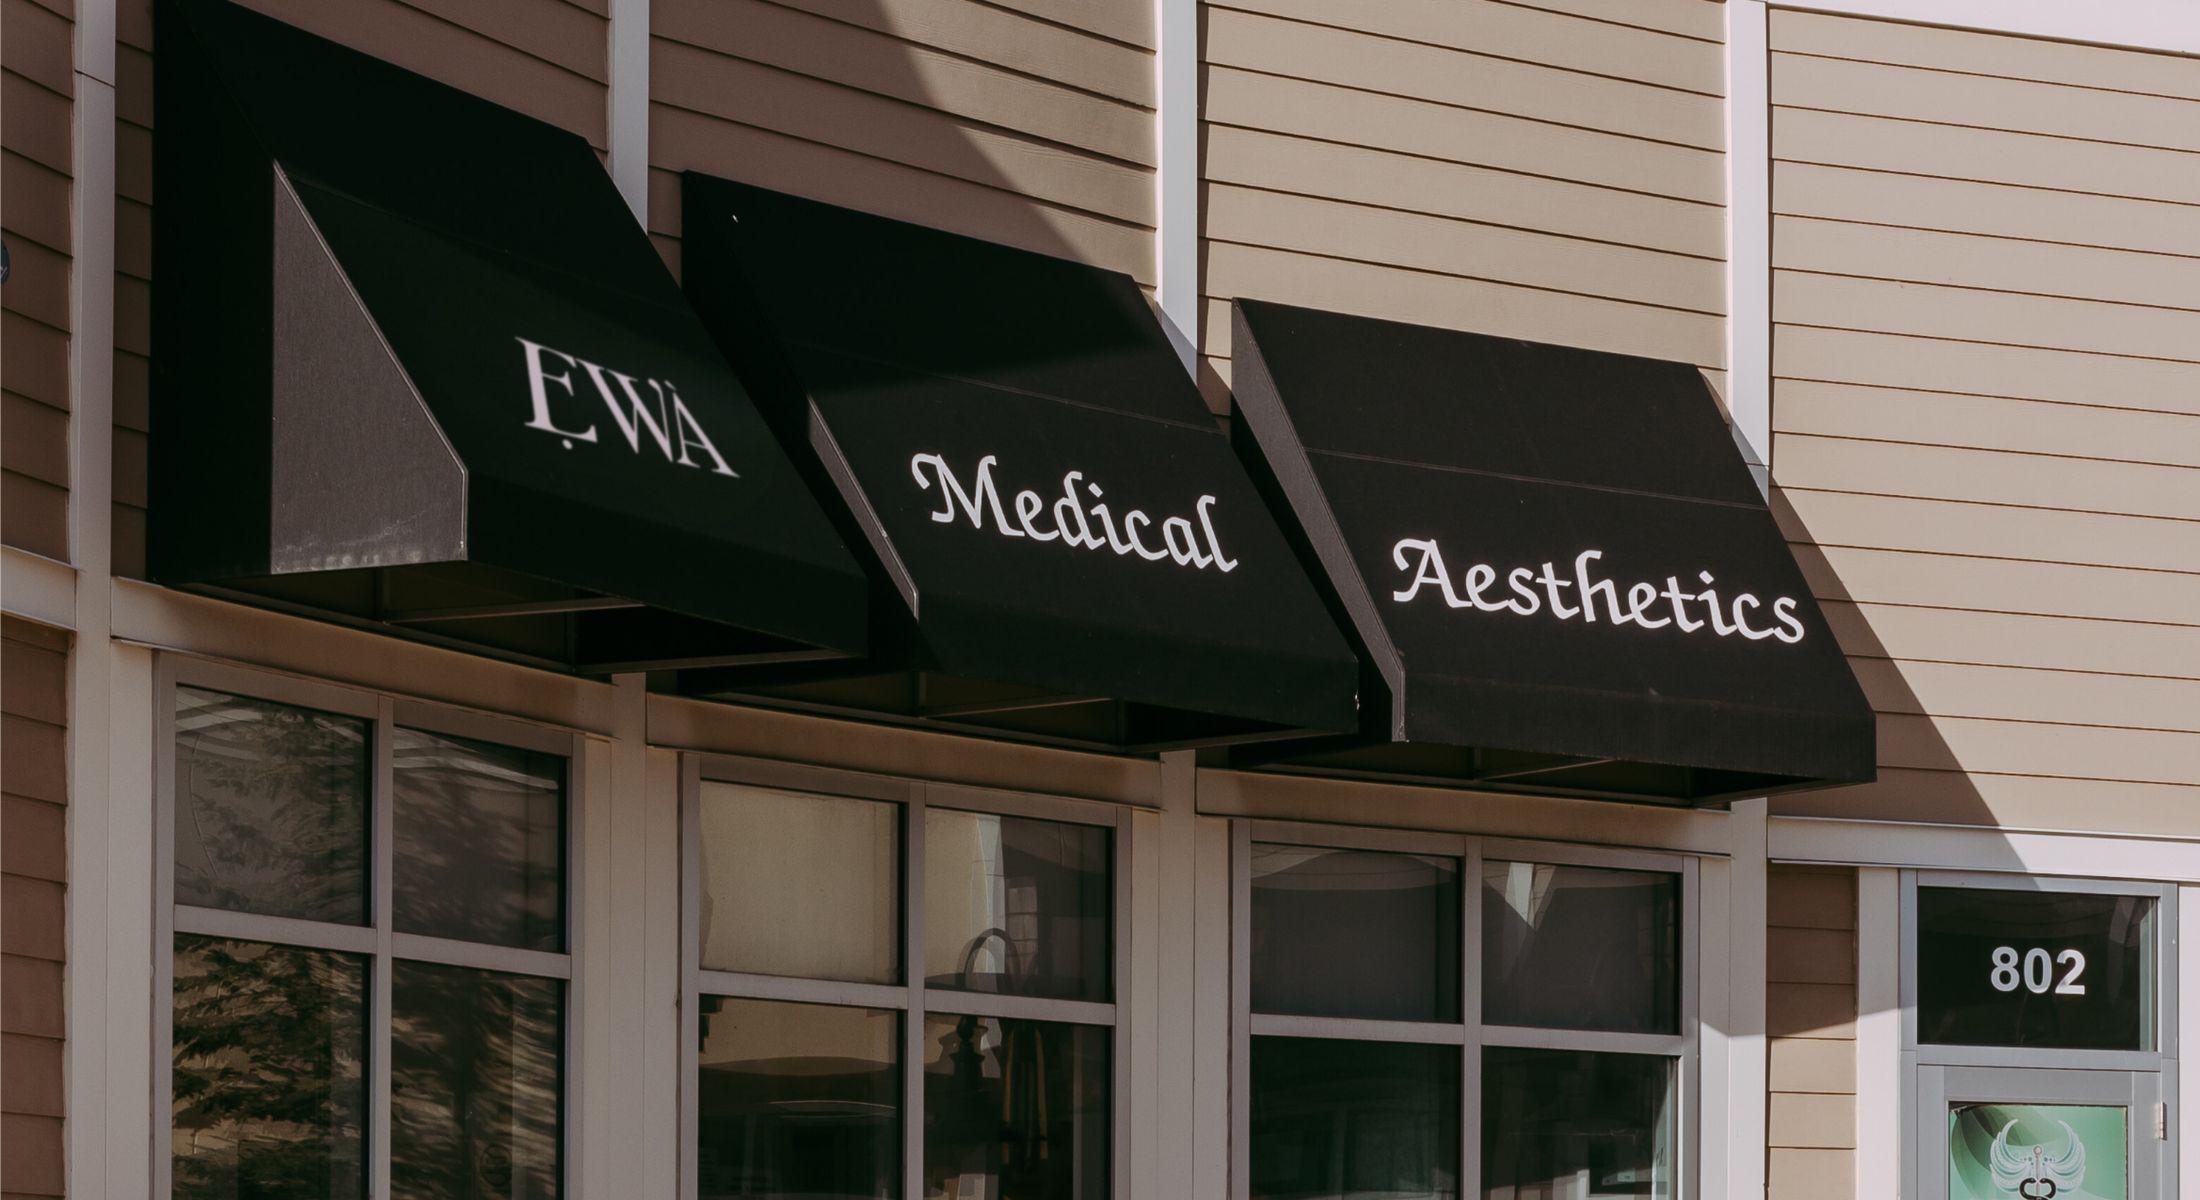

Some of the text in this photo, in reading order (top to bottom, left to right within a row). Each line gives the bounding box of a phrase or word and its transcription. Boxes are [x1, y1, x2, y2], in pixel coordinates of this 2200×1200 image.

[911, 453, 1239, 573] Medical
[1392, 537, 1805, 644] Aesthetics
[1990, 946, 2086, 995] 802
